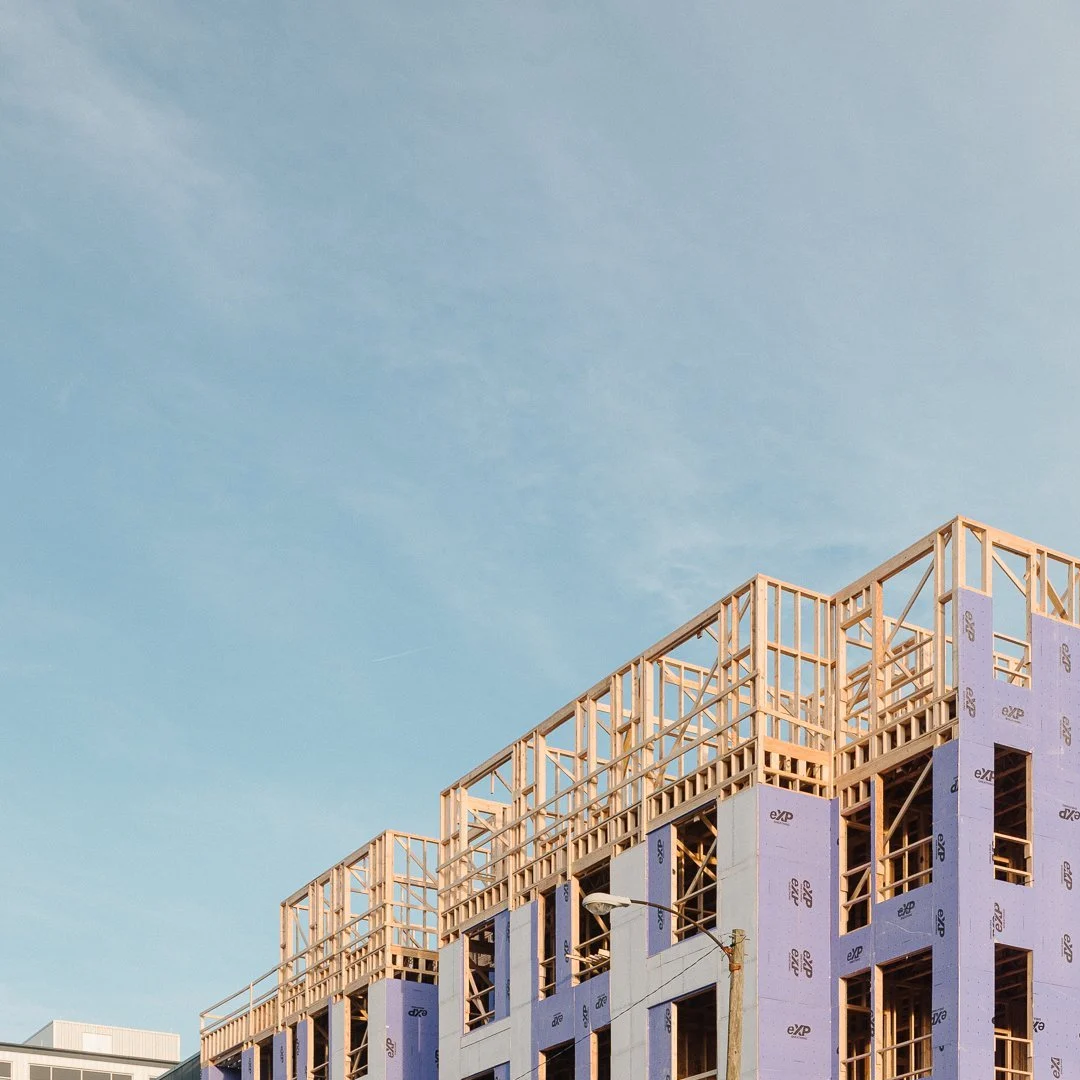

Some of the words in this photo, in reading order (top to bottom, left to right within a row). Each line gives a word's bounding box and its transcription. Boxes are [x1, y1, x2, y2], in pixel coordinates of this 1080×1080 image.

[965, 611, 975, 642] eXP
[1062, 643, 1071, 674] eXP
[966, 687, 976, 718] eXP
[1002, 705, 1024, 720] eXP
[1062, 716, 1071, 747] eXP
[770, 810, 794, 822] eXP
[1059, 808, 1080, 821] eXP
[1064, 861, 1072, 890] eXP
[803, 880, 813, 908] eXP
[898, 901, 915, 917] eXP
[847, 946, 863, 961] eXP
[1064, 934, 1072, 963] eXP
[803, 950, 813, 978] eXP
[595, 995, 607, 1009] eXP
[408, 1010, 427, 1018] eXP
[552, 1014, 563, 1028] eXP
[787, 1024, 811, 1037] eXP
[386, 1038, 395, 1058] eXP
